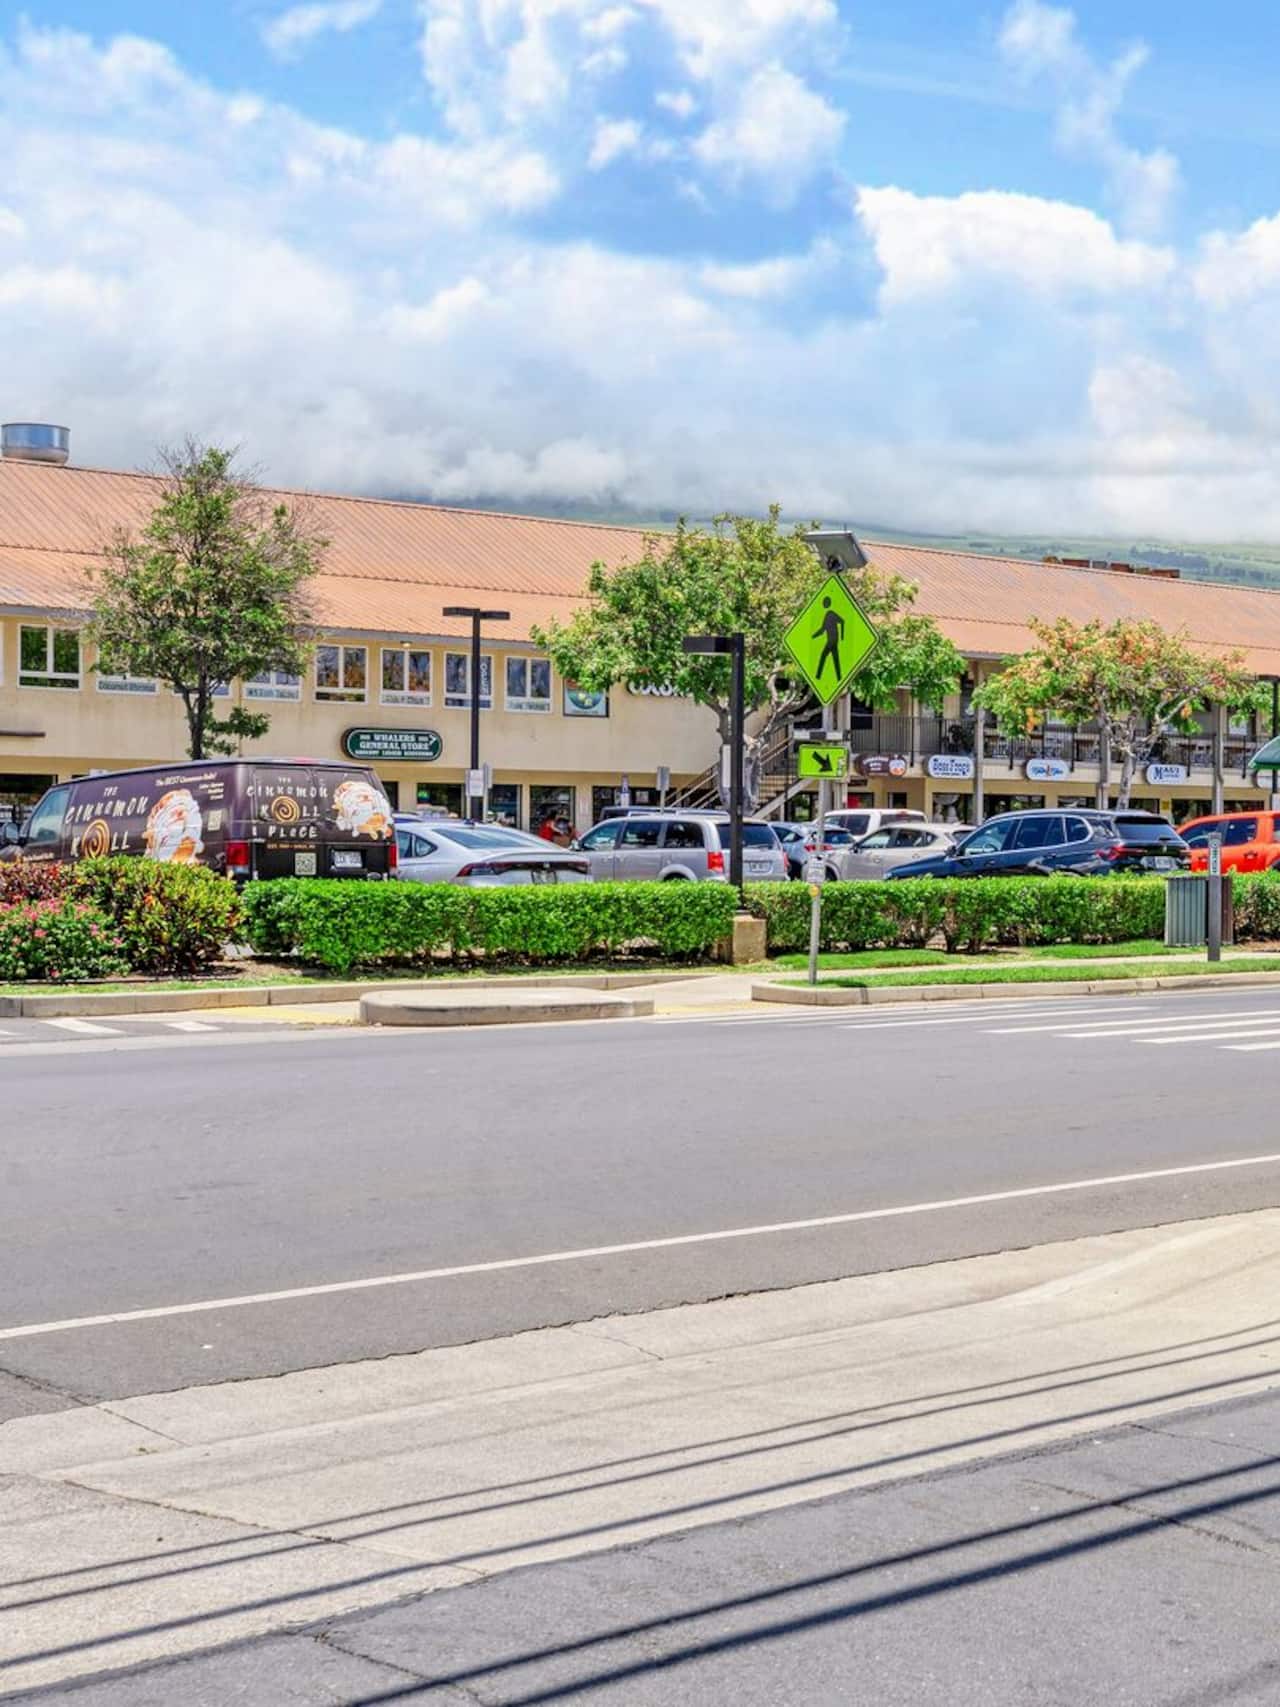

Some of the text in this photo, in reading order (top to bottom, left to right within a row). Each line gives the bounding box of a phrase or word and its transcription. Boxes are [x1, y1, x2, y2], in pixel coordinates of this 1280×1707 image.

[373, 734, 416, 742] WHALERS
[359, 741, 430, 750] GENERAL STORE
[268, 826, 318, 838] PLACE
